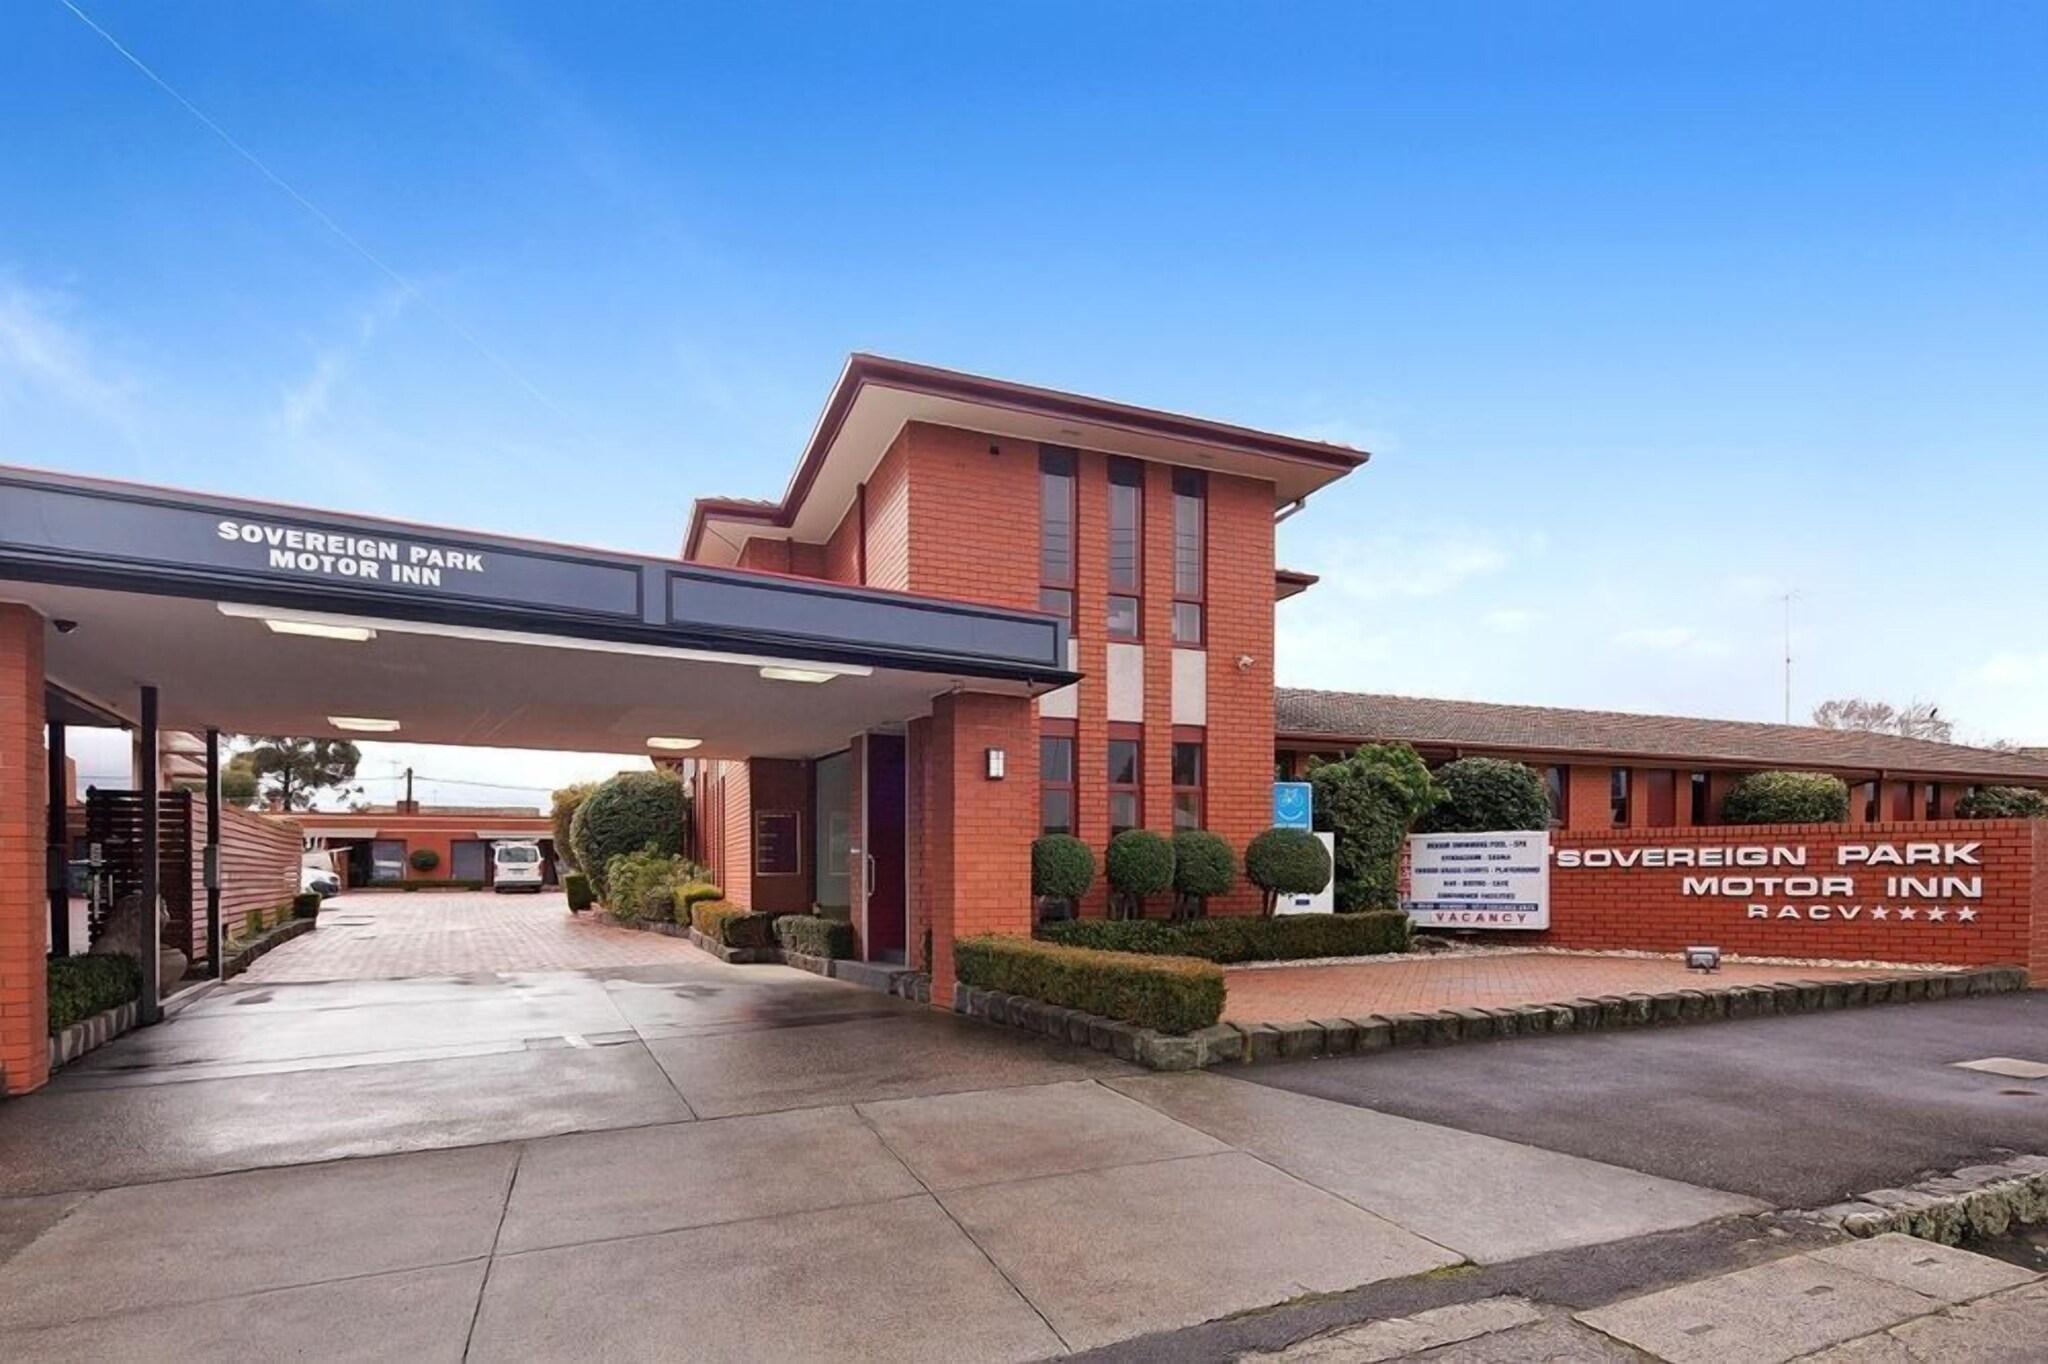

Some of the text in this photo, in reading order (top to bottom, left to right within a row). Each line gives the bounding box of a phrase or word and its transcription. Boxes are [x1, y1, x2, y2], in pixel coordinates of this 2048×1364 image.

[217, 521, 484, 572] SOVEREIGN PARK
[269, 549, 441, 587] MOTOR INN
[1556, 842, 1981, 868] SOVEREIGN PARK
[1682, 877, 1982, 898] MOTOR INN
[1436, 913, 1527, 922] VACANCY
[1748, 905, 1861, 920] RACV
